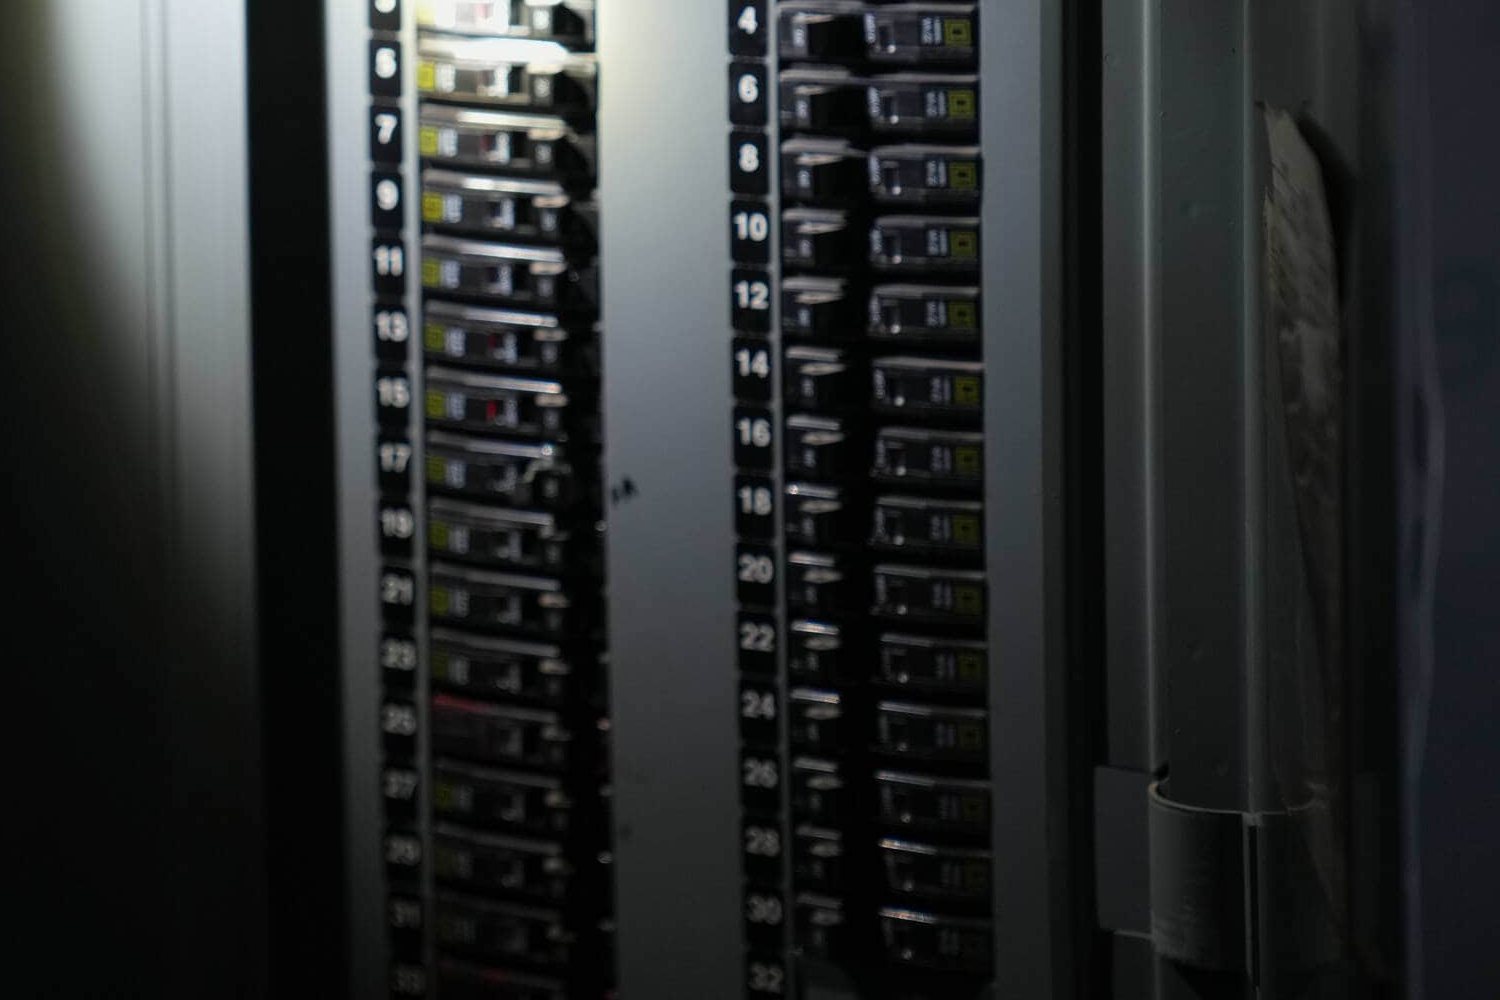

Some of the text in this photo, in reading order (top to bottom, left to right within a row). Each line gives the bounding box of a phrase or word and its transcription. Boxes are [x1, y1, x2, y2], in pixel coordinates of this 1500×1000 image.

[738, 6, 758, 34] 4
[738, 74, 758, 103] 6
[375, 114, 397, 144] 7
[739, 143, 759, 172] 8
[735, 212, 768, 241] 10
[374, 246, 403, 275] 11
[736, 281, 769, 310] 12
[737, 349, 769, 377] 14
[738, 418, 771, 447] 16
[379, 441, 412, 473] 17
[739, 487, 772, 515] 18
[739, 554, 774, 584] 20
[741, 623, 775, 652] 22
[742, 691, 775, 719] 24
